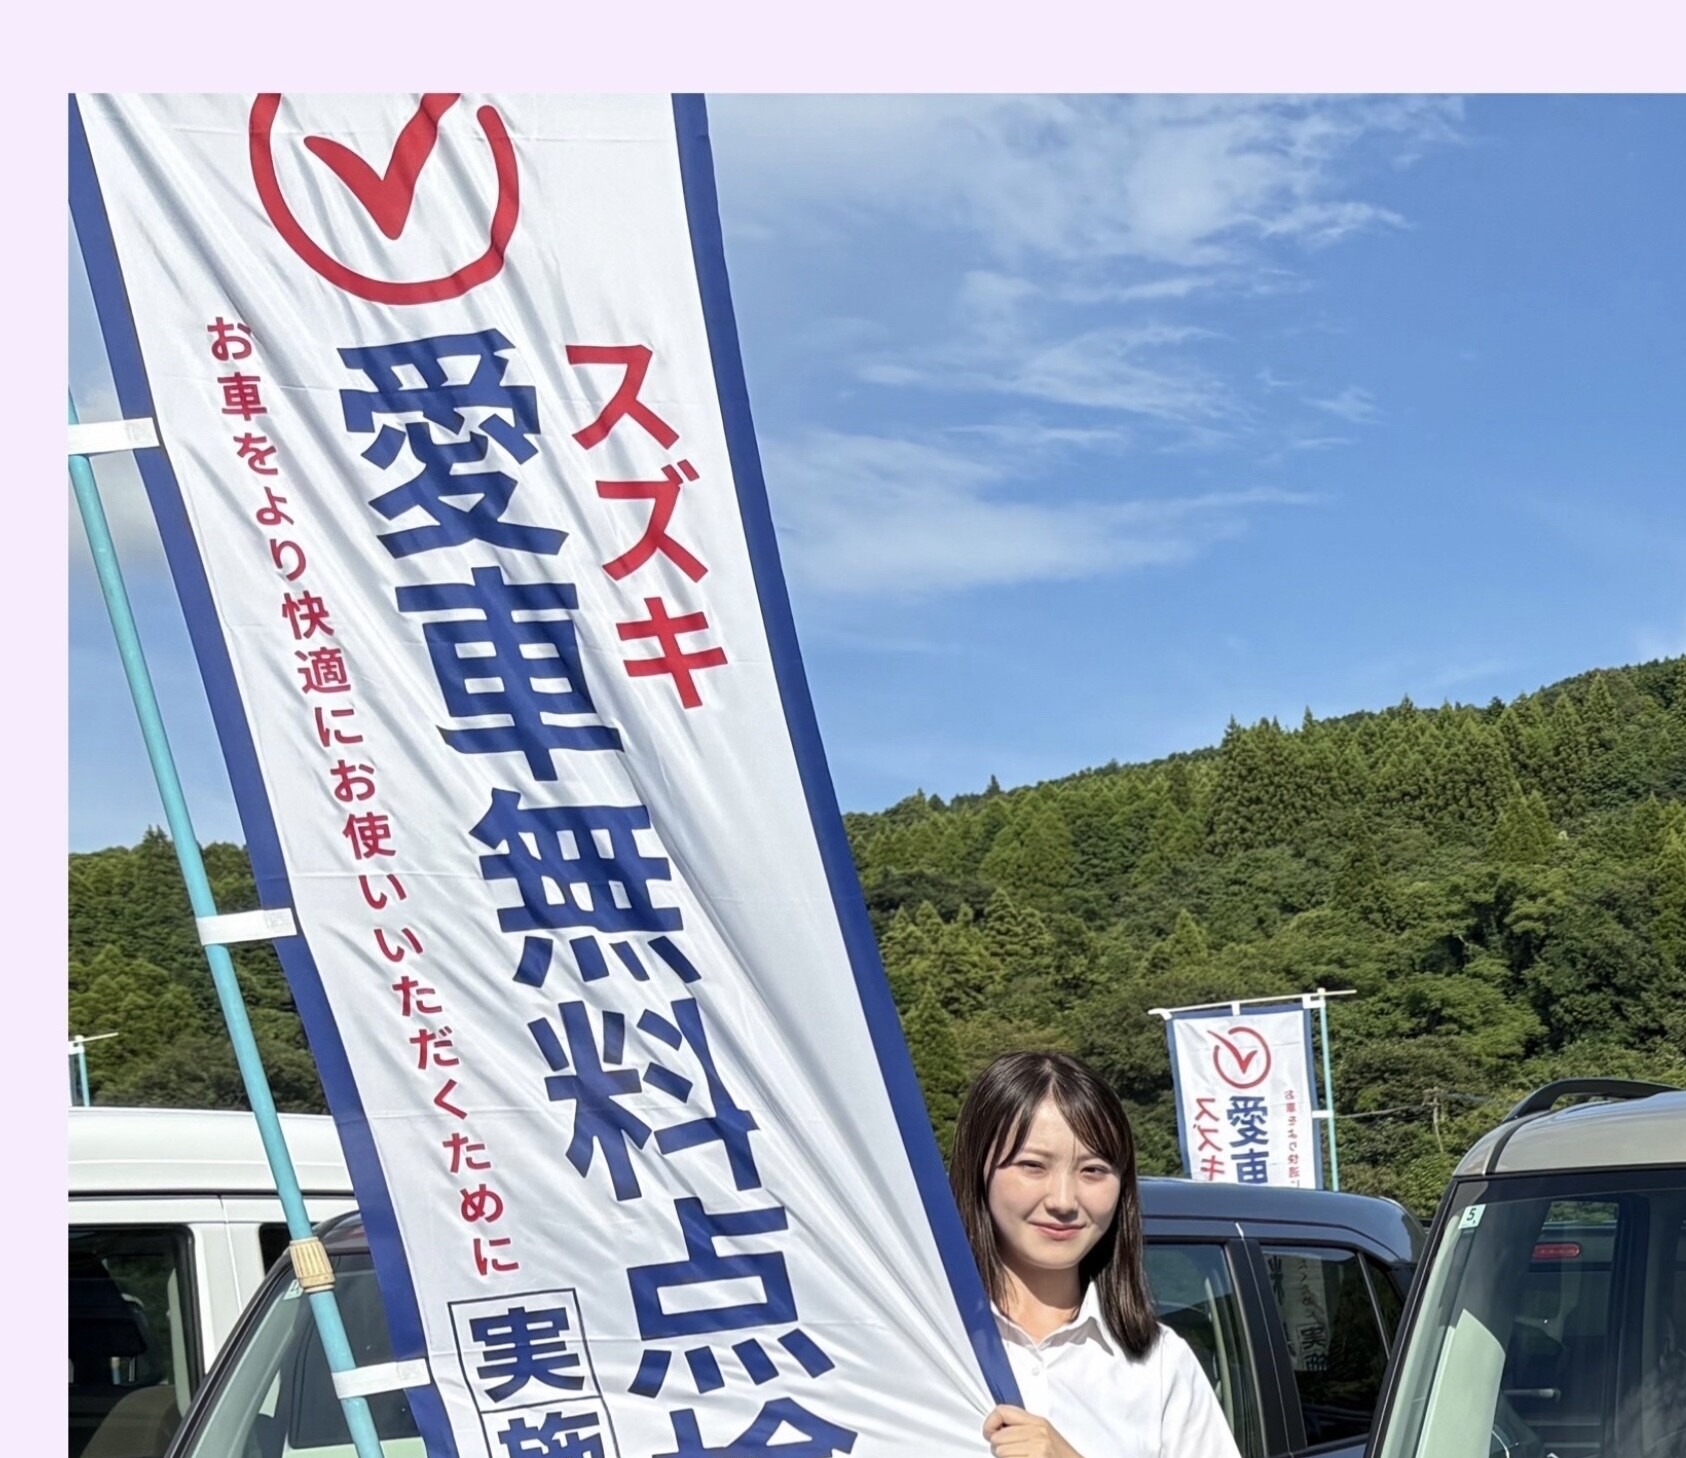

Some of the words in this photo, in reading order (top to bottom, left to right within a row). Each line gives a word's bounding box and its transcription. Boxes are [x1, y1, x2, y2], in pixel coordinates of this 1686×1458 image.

[206, 316, 519, 1275] お車をより快適にお使いいただくために
[566, 344, 728, 708] スズキ
